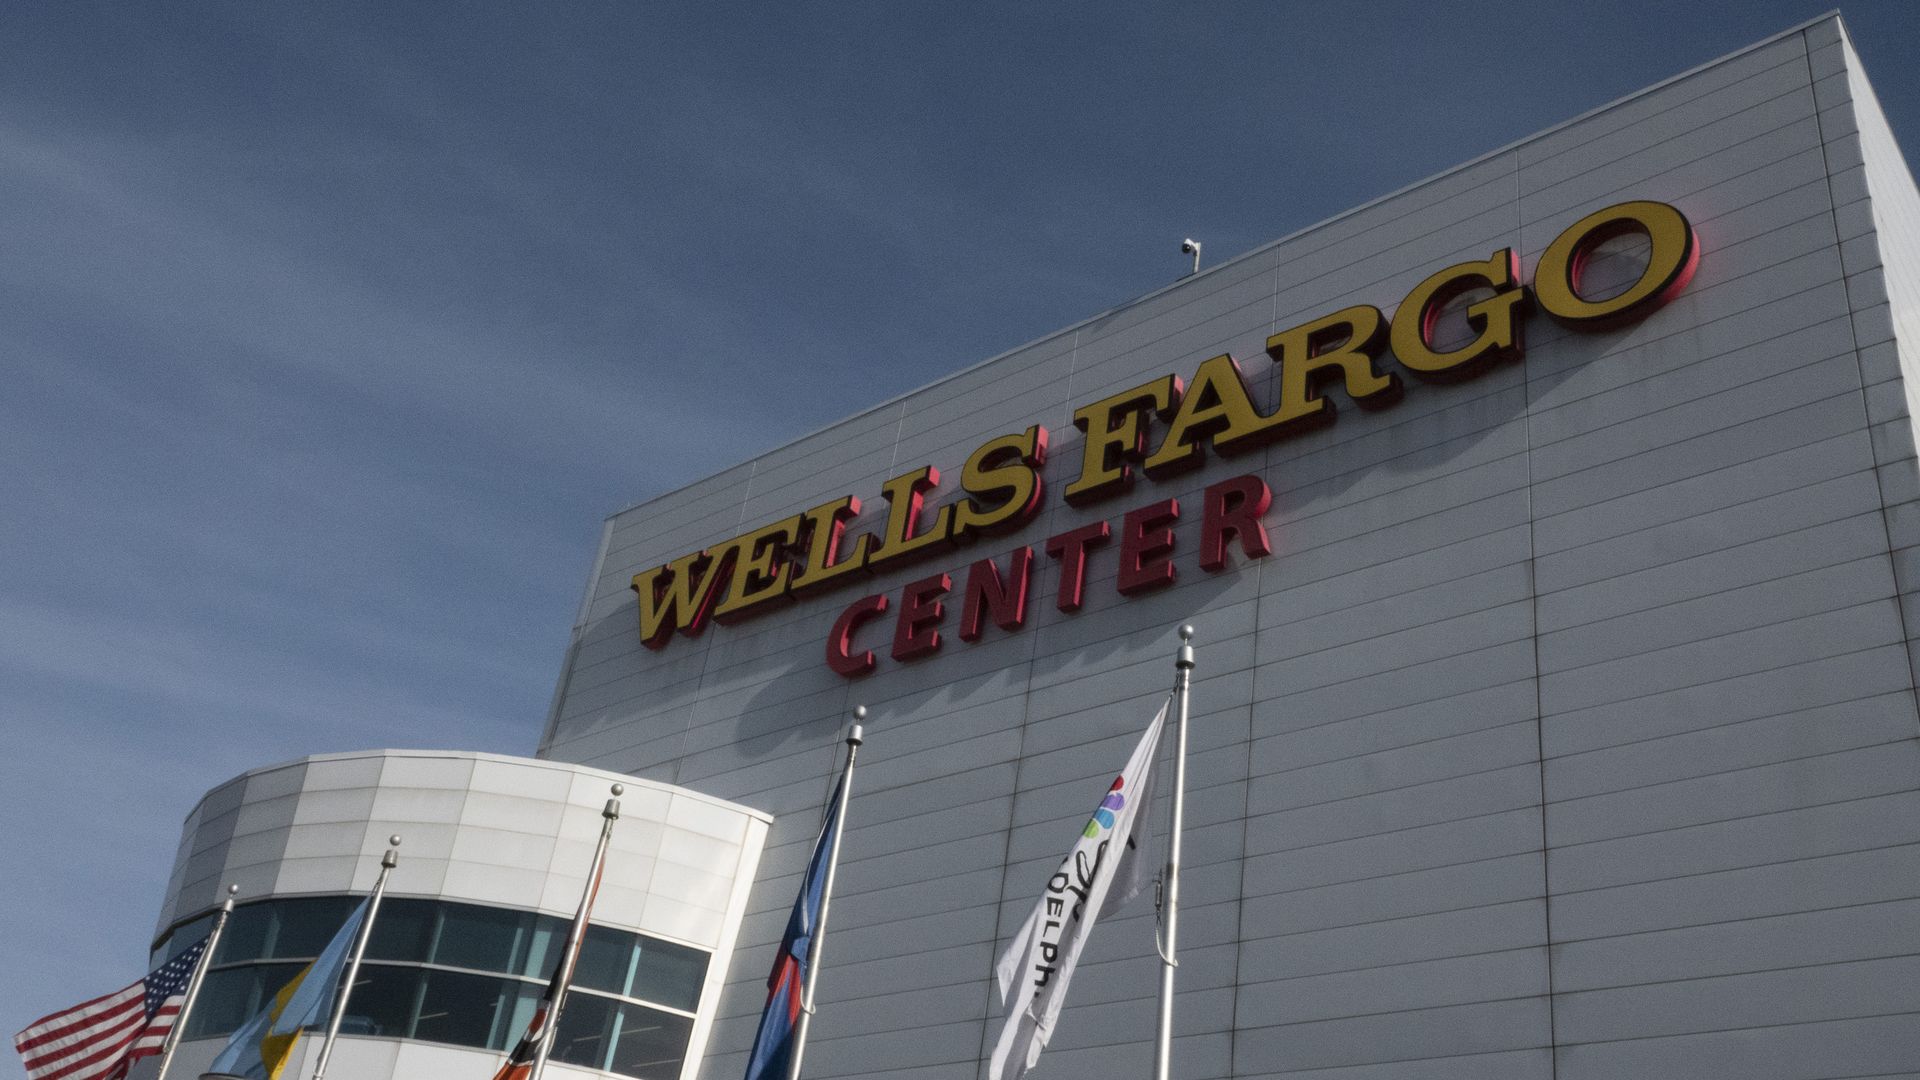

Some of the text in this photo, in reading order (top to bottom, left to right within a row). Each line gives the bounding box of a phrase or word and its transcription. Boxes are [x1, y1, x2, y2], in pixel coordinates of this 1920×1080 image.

[631, 200, 1700, 650] WELLS FARGO
[826, 474, 1272, 677] CENTER
